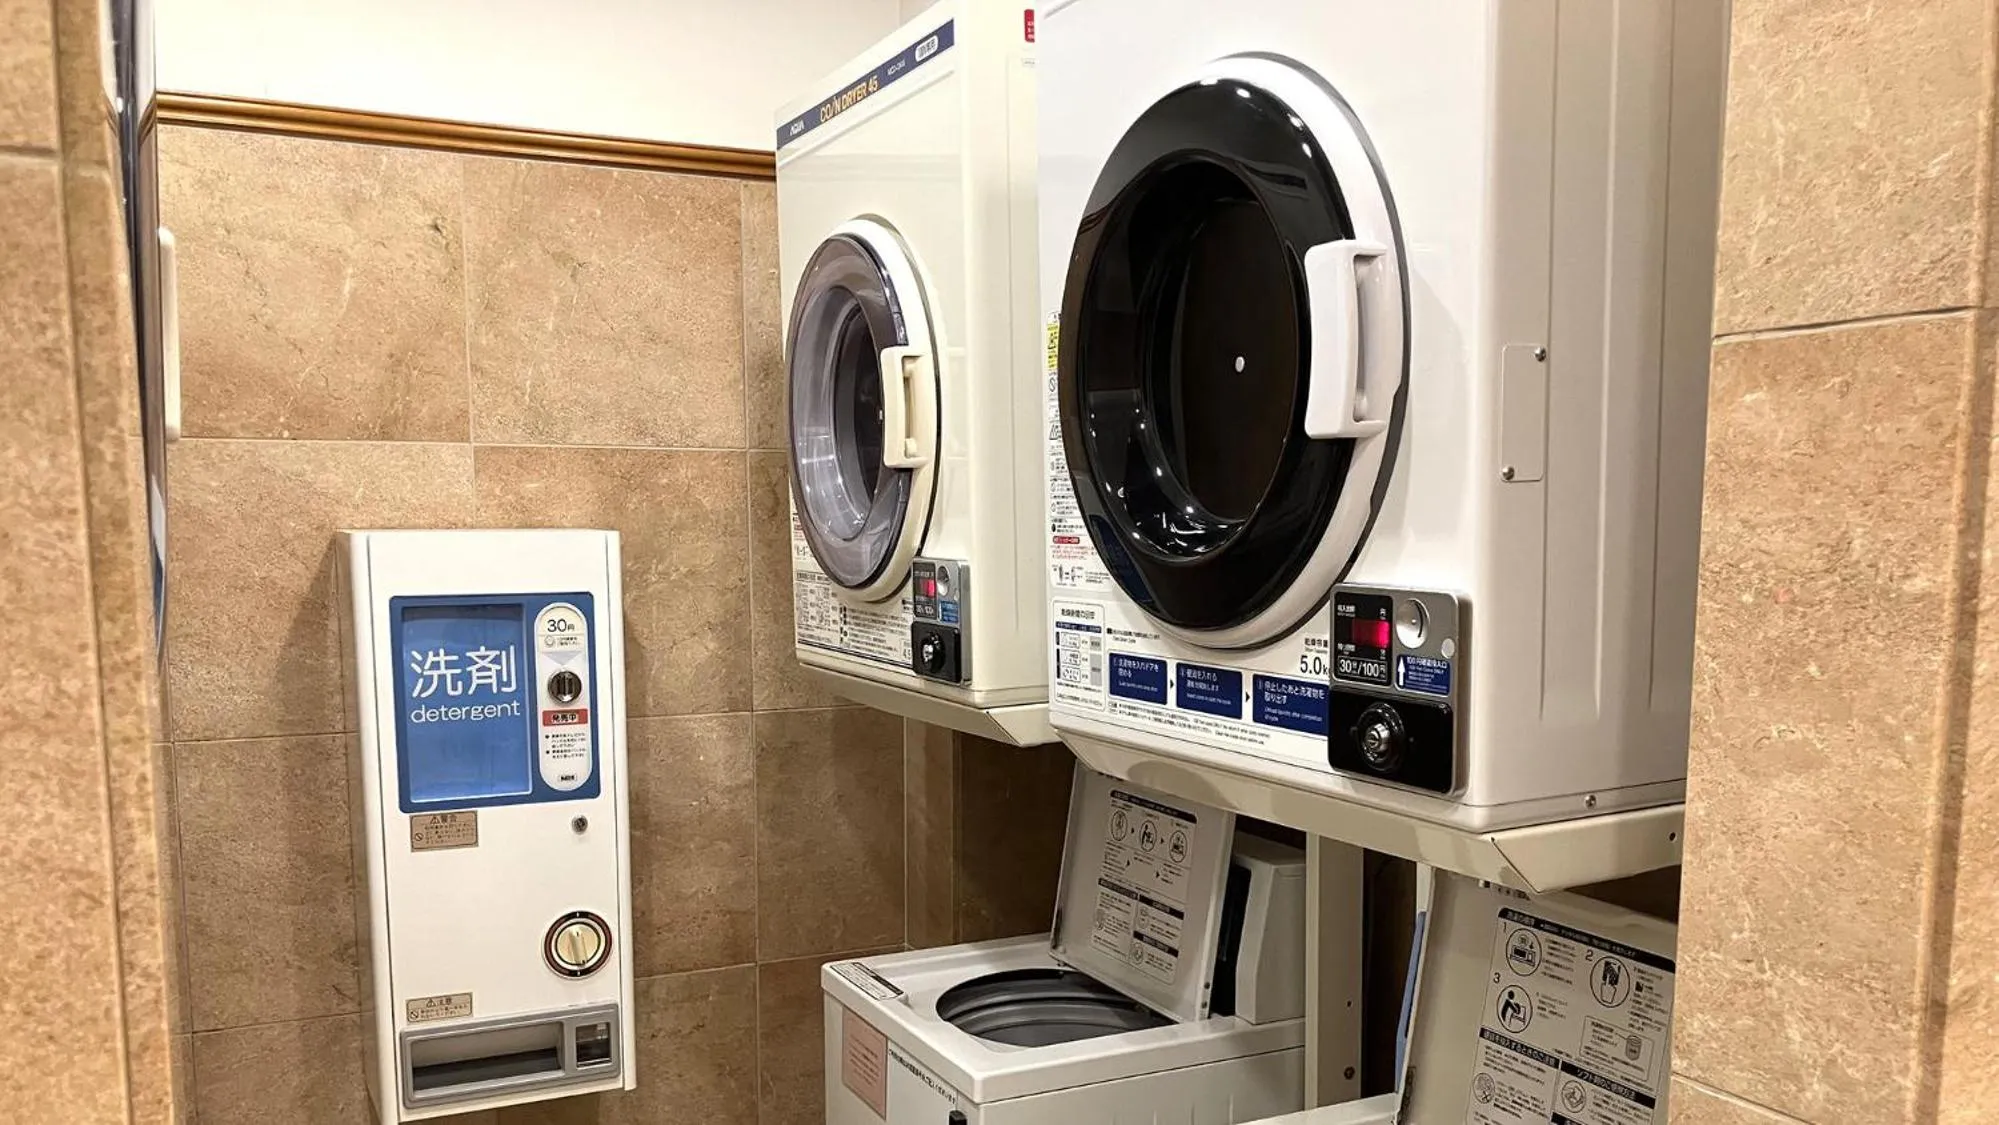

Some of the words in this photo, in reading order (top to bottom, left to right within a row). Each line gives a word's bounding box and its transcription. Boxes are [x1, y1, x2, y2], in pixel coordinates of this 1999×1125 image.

[841, 82, 867, 110] DRYER
[867, 75, 879, 93] 45
[547, 618, 576, 633] 30円
[410, 645, 518, 698] 洗剤
[1300, 654, 1329, 676] 5.0k
[410, 699, 521, 724] detergent
[1585, 950, 1594, 962] 2
[1493, 972, 1500, 984] 3
